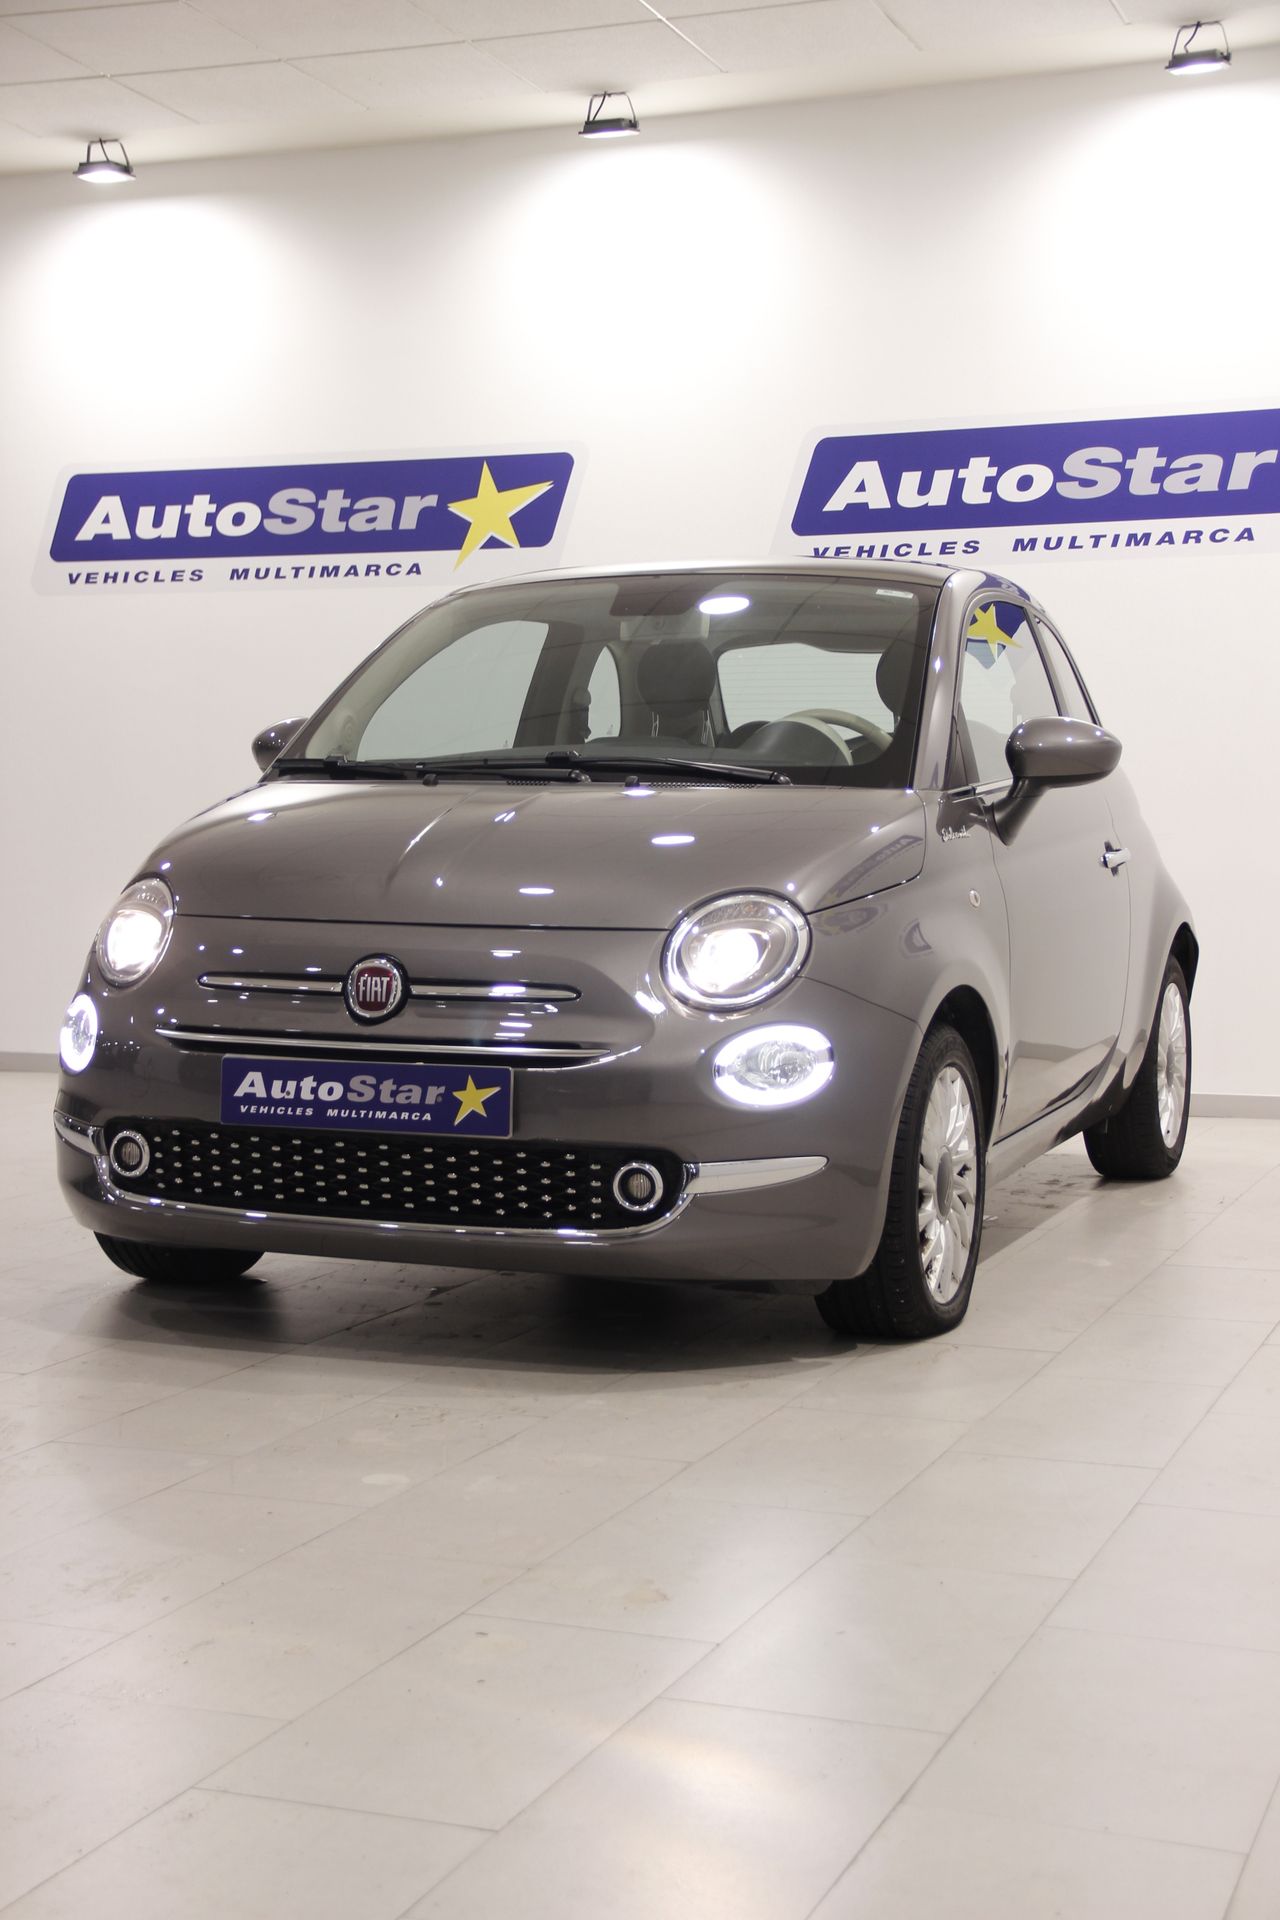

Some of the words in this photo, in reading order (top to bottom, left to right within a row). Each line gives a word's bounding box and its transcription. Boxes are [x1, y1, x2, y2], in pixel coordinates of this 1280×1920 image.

[821, 445, 1279, 512] AutoStar
[74, 487, 438, 542] AutoStar
[813, 539, 981, 559] VEHICLES
[1012, 526, 1256, 553] MULTIMARCA
[68, 568, 204, 585] VEHICLES
[229, 562, 423, 581] MULTIMARCA
[359, 976, 390, 1003] FIAT
[233, 1071, 446, 1105] AutoStar
[240, 1104, 314, 1116] VEHICLES
[326, 1108, 432, 1121] MULTIMARCA
